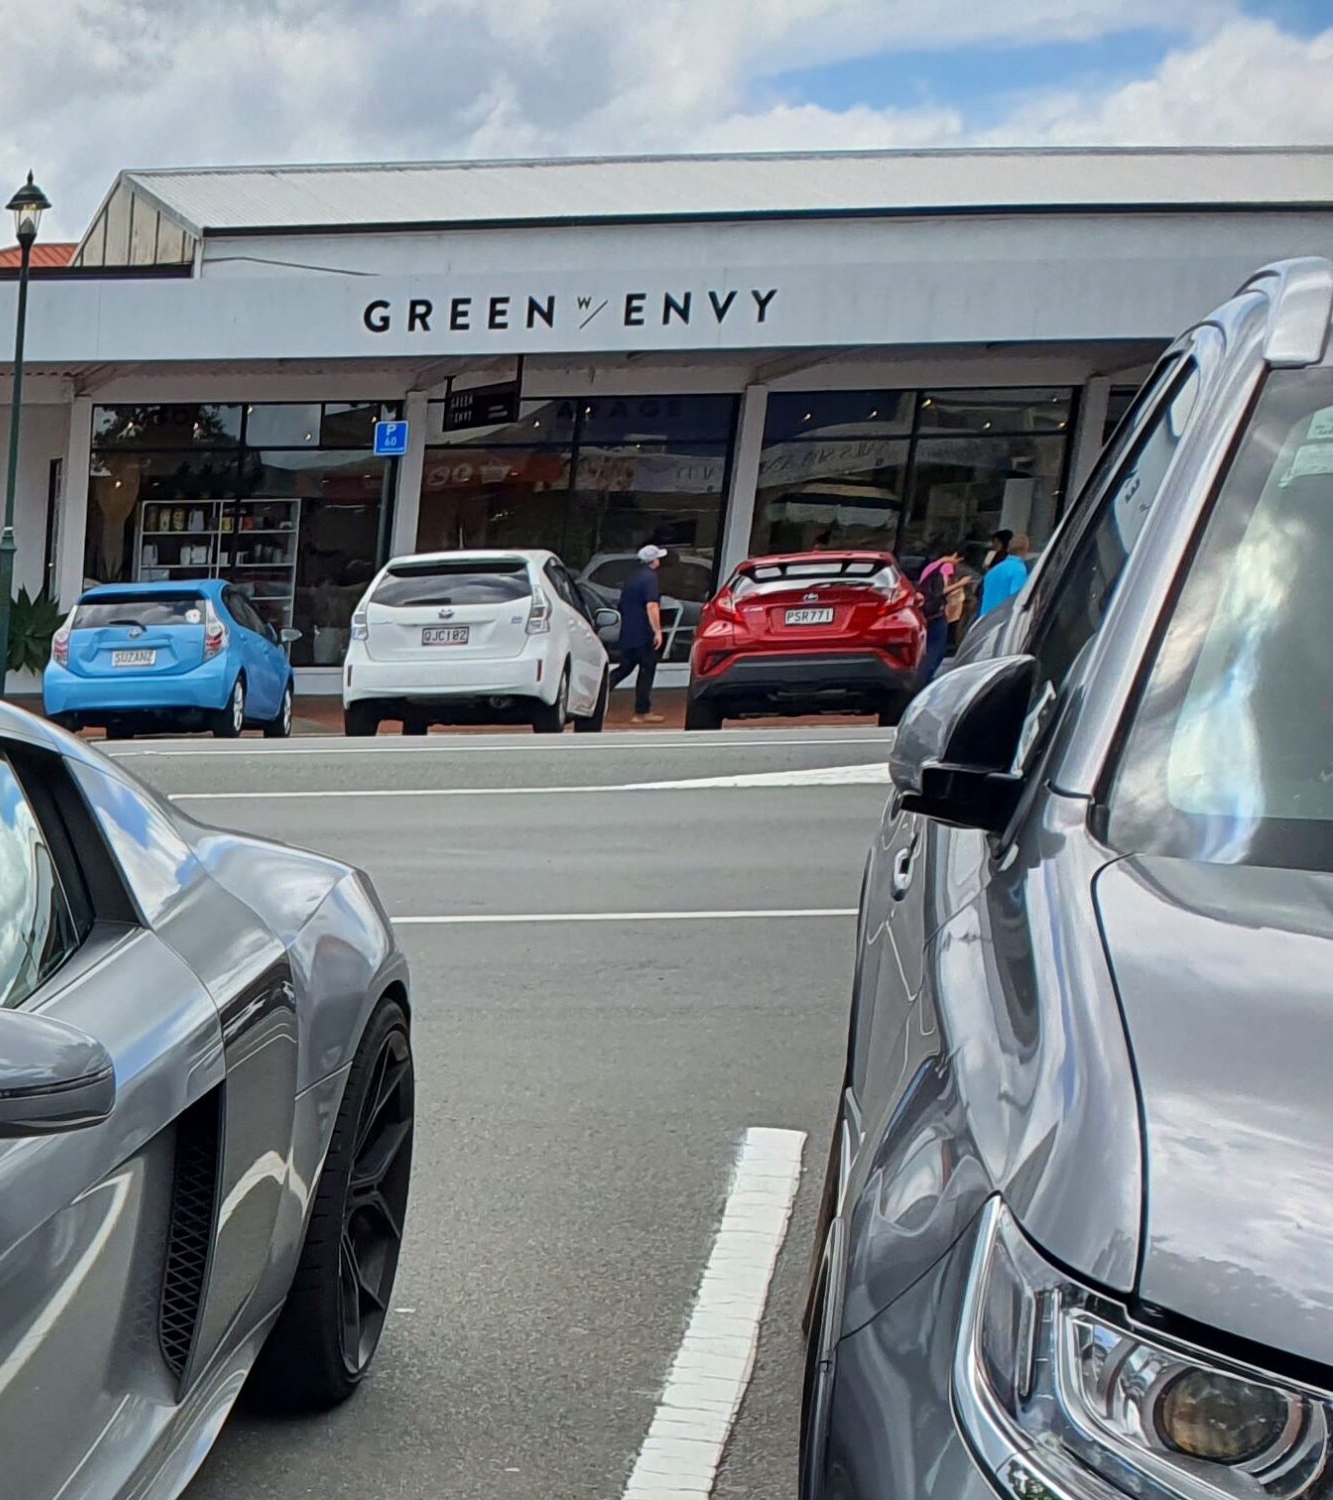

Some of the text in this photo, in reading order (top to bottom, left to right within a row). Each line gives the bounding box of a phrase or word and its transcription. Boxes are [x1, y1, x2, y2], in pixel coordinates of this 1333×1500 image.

[362, 295, 556, 333] GREEN
[623, 288, 779, 327] ENVY
[386, 424, 398, 436] P
[384, 436, 397, 447] 60
[786, 610, 831, 622] PSR771
